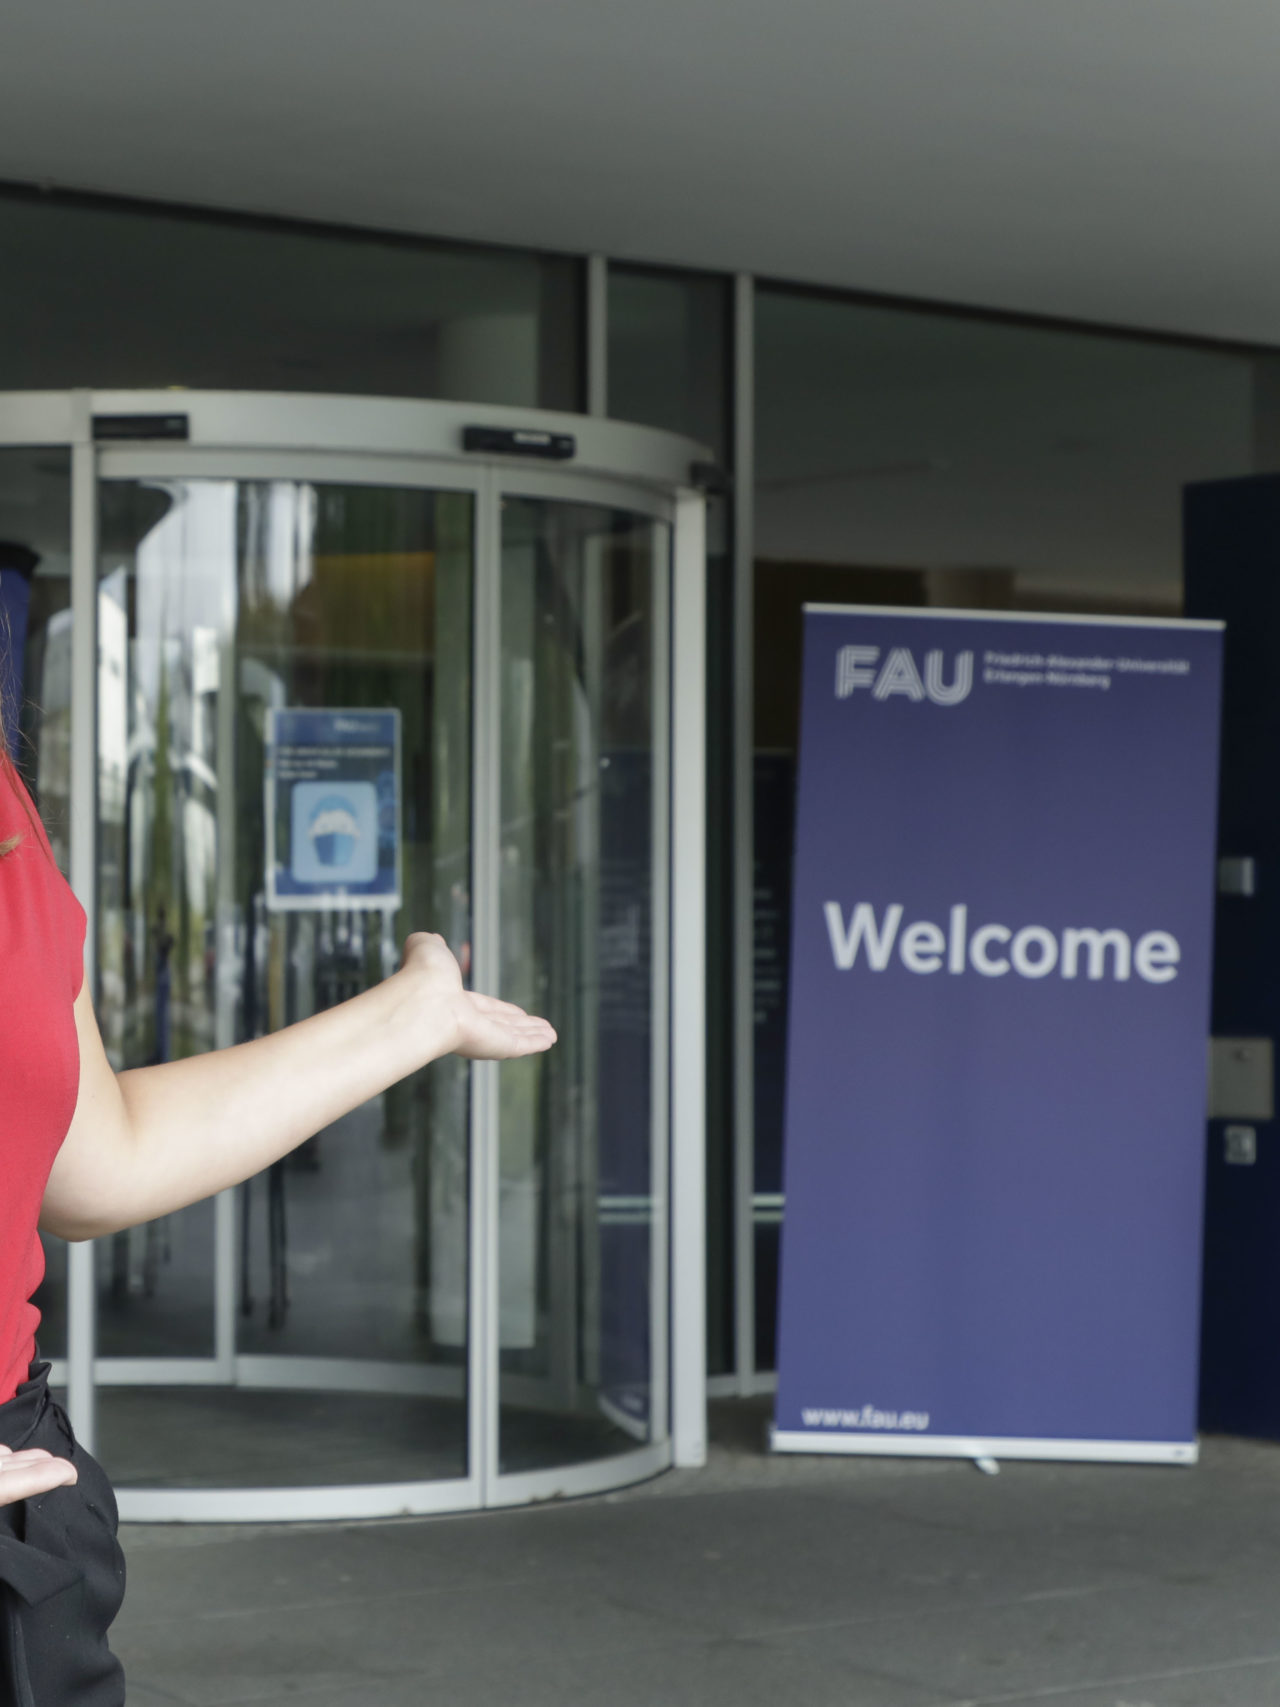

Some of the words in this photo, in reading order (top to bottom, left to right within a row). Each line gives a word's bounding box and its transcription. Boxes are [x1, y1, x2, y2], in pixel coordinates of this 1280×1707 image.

[835, 645, 974, 706] FAU
[823, 901, 1181, 983] Welcome
[802, 1405, 930, 1431] www.fau.eu
